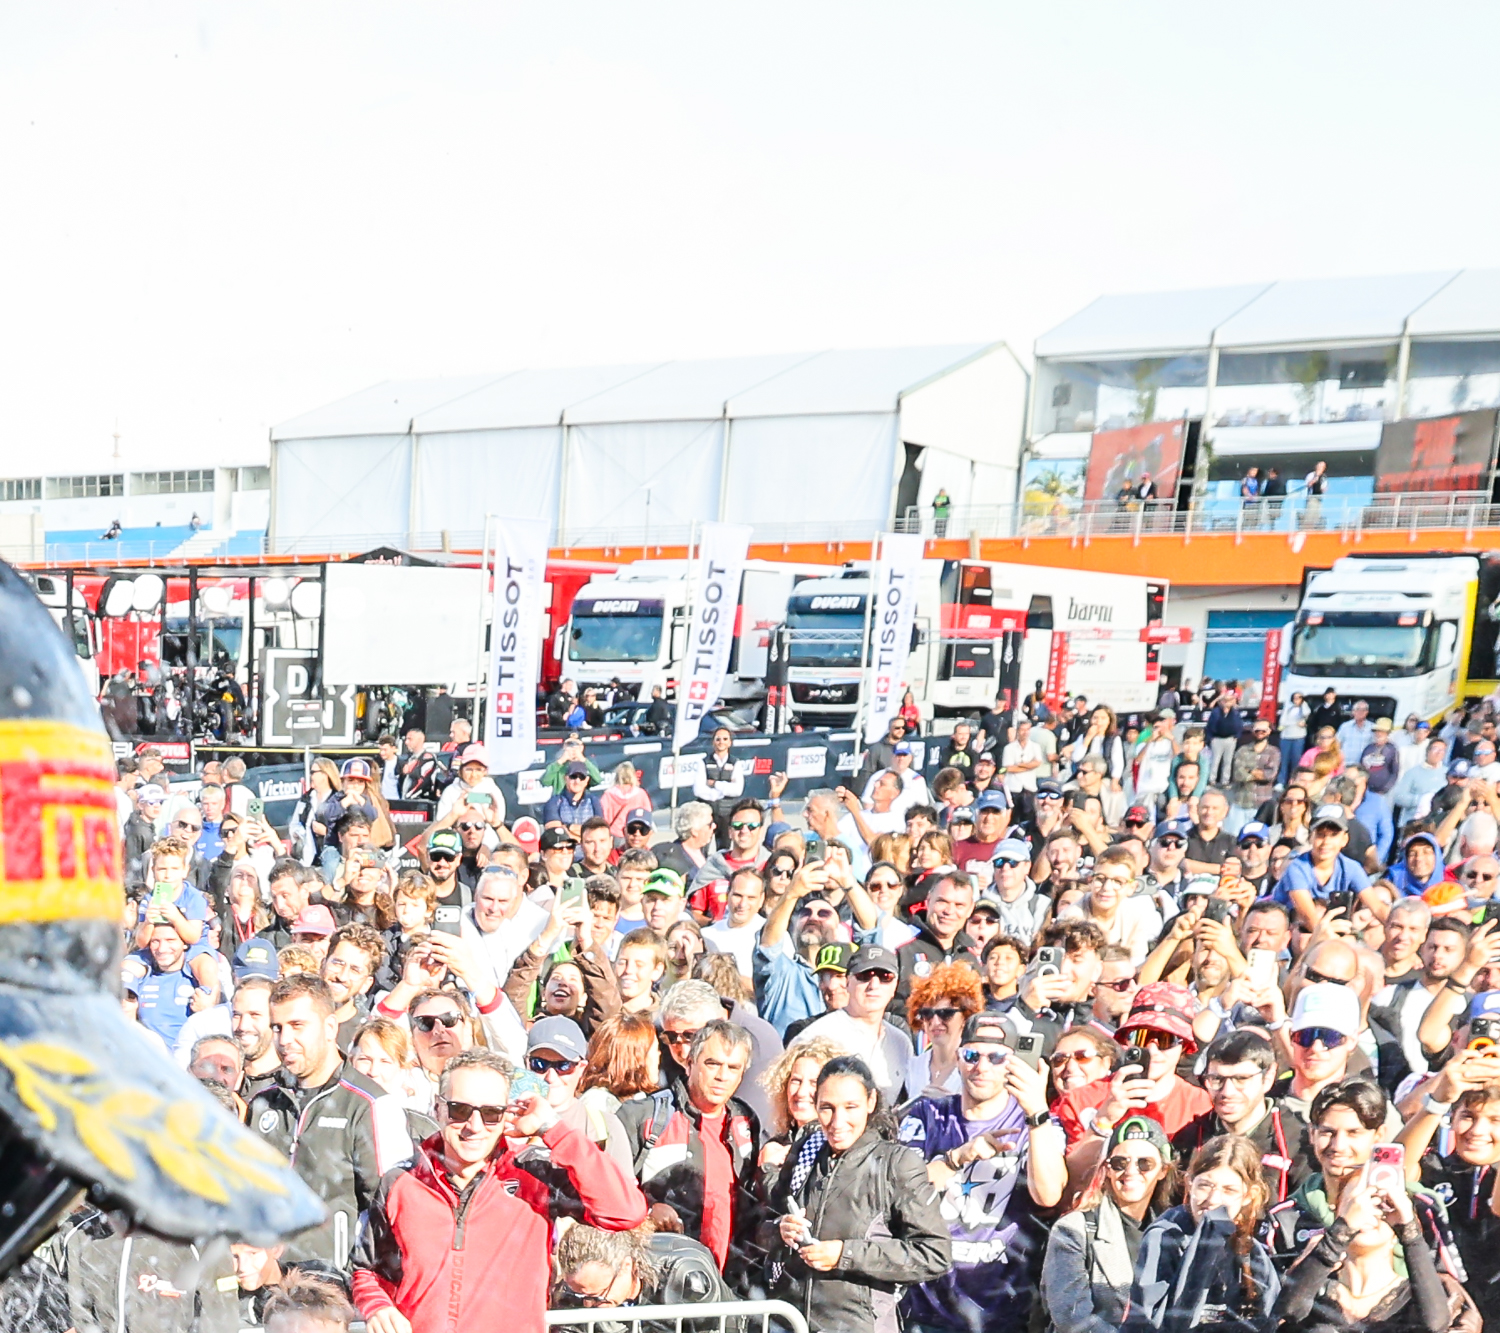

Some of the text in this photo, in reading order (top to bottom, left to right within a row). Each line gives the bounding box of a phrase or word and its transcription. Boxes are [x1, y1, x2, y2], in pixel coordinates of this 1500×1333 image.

[497, 556, 524, 687] TISSOT
[592, 600, 640, 613] DUCATI
[693, 559, 727, 676] TISSOT
[810, 596, 861, 609] DUCATI
[878, 567, 906, 672] TISSOT
[1067, 596, 1114, 624] barni
[451, 1254, 465, 1318] DUCATI
